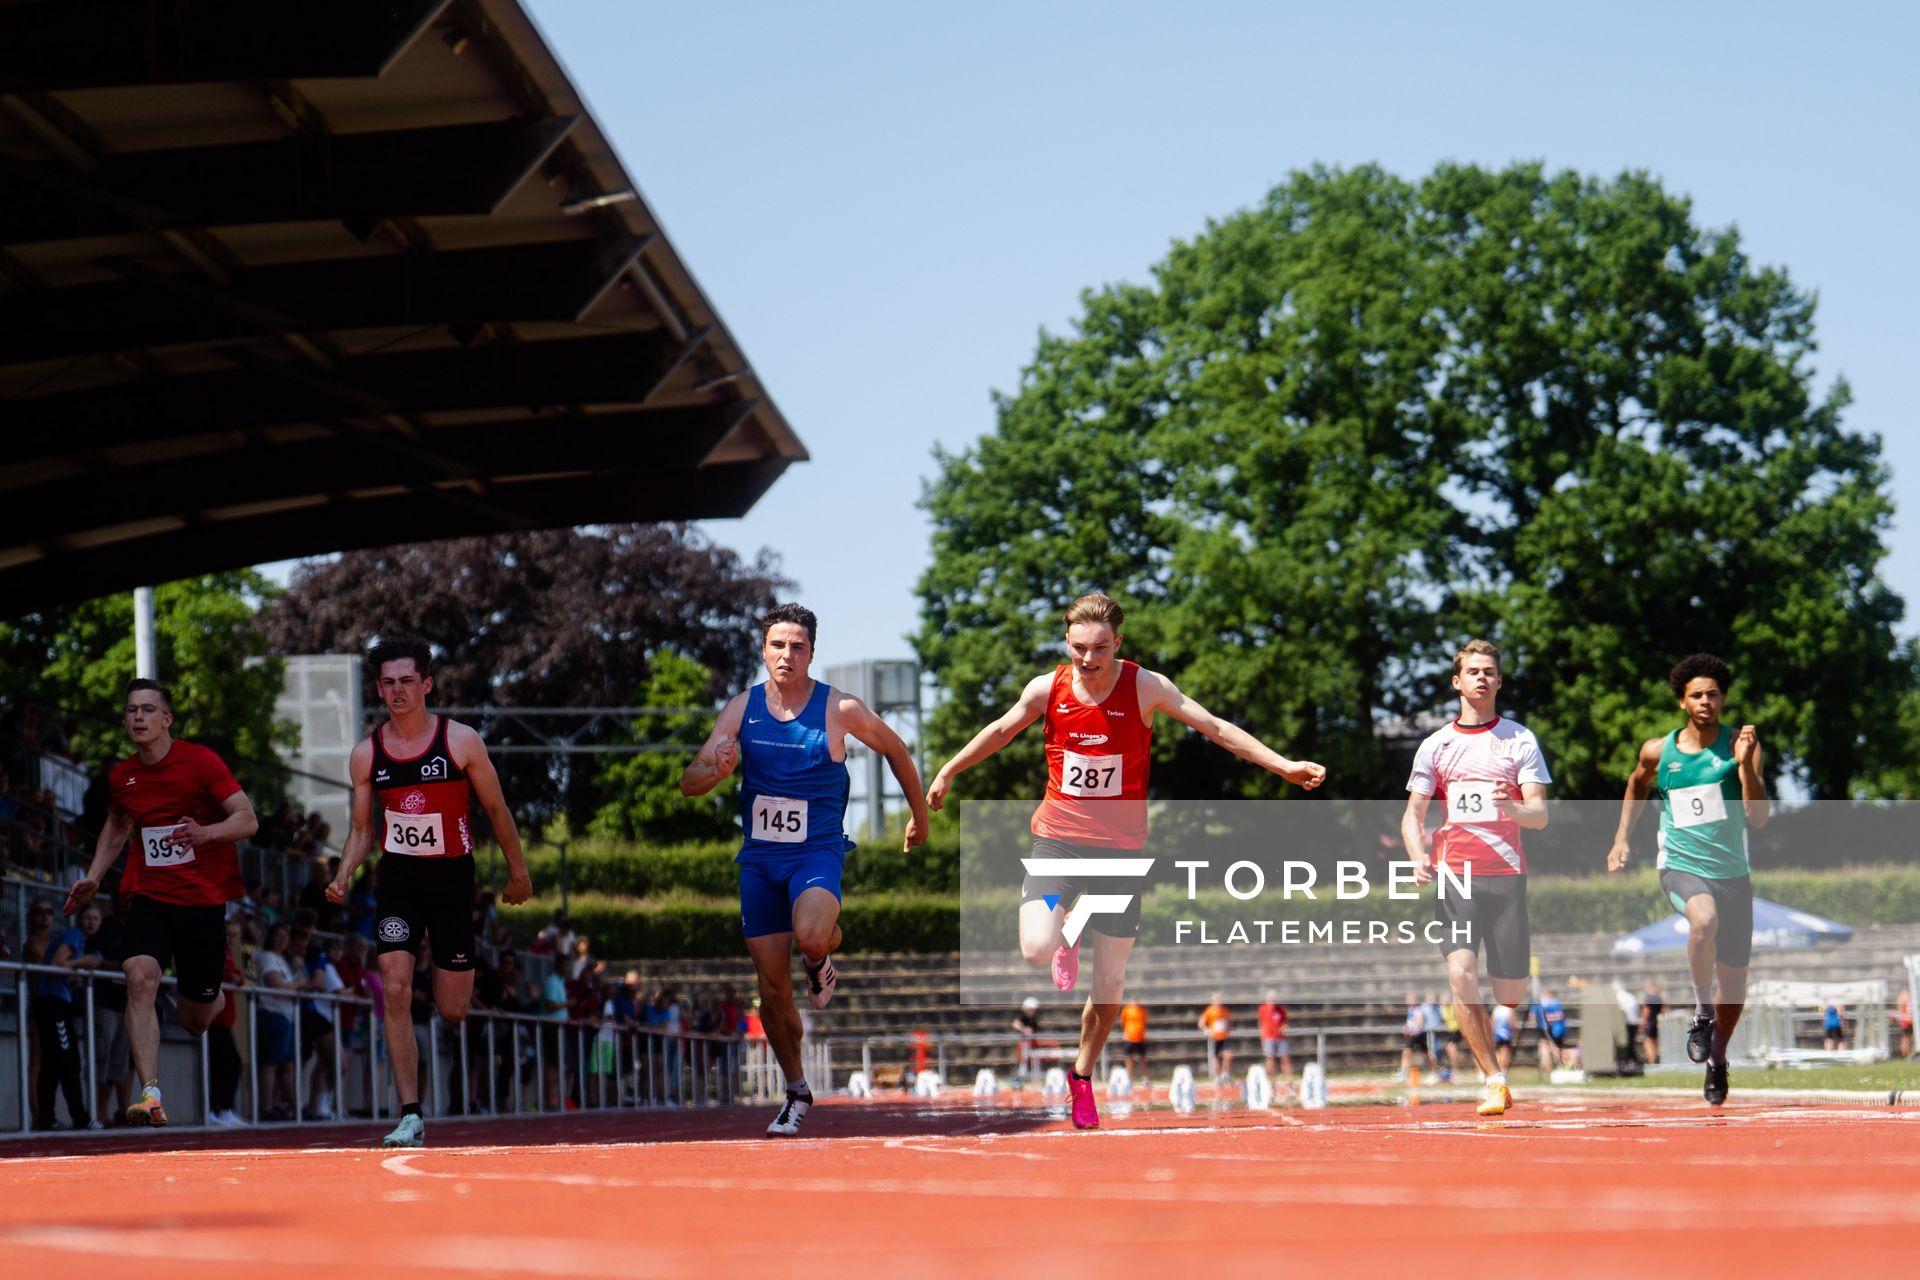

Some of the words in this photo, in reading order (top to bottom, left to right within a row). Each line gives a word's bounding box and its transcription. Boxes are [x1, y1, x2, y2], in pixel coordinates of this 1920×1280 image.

[421, 764, 440, 776] OS
[1069, 766, 1116, 788] 287
[1456, 793, 1483, 813] 43
[1691, 798, 1704, 816] 9
[759, 808, 802, 833] 145
[393, 823, 437, 847] 364
